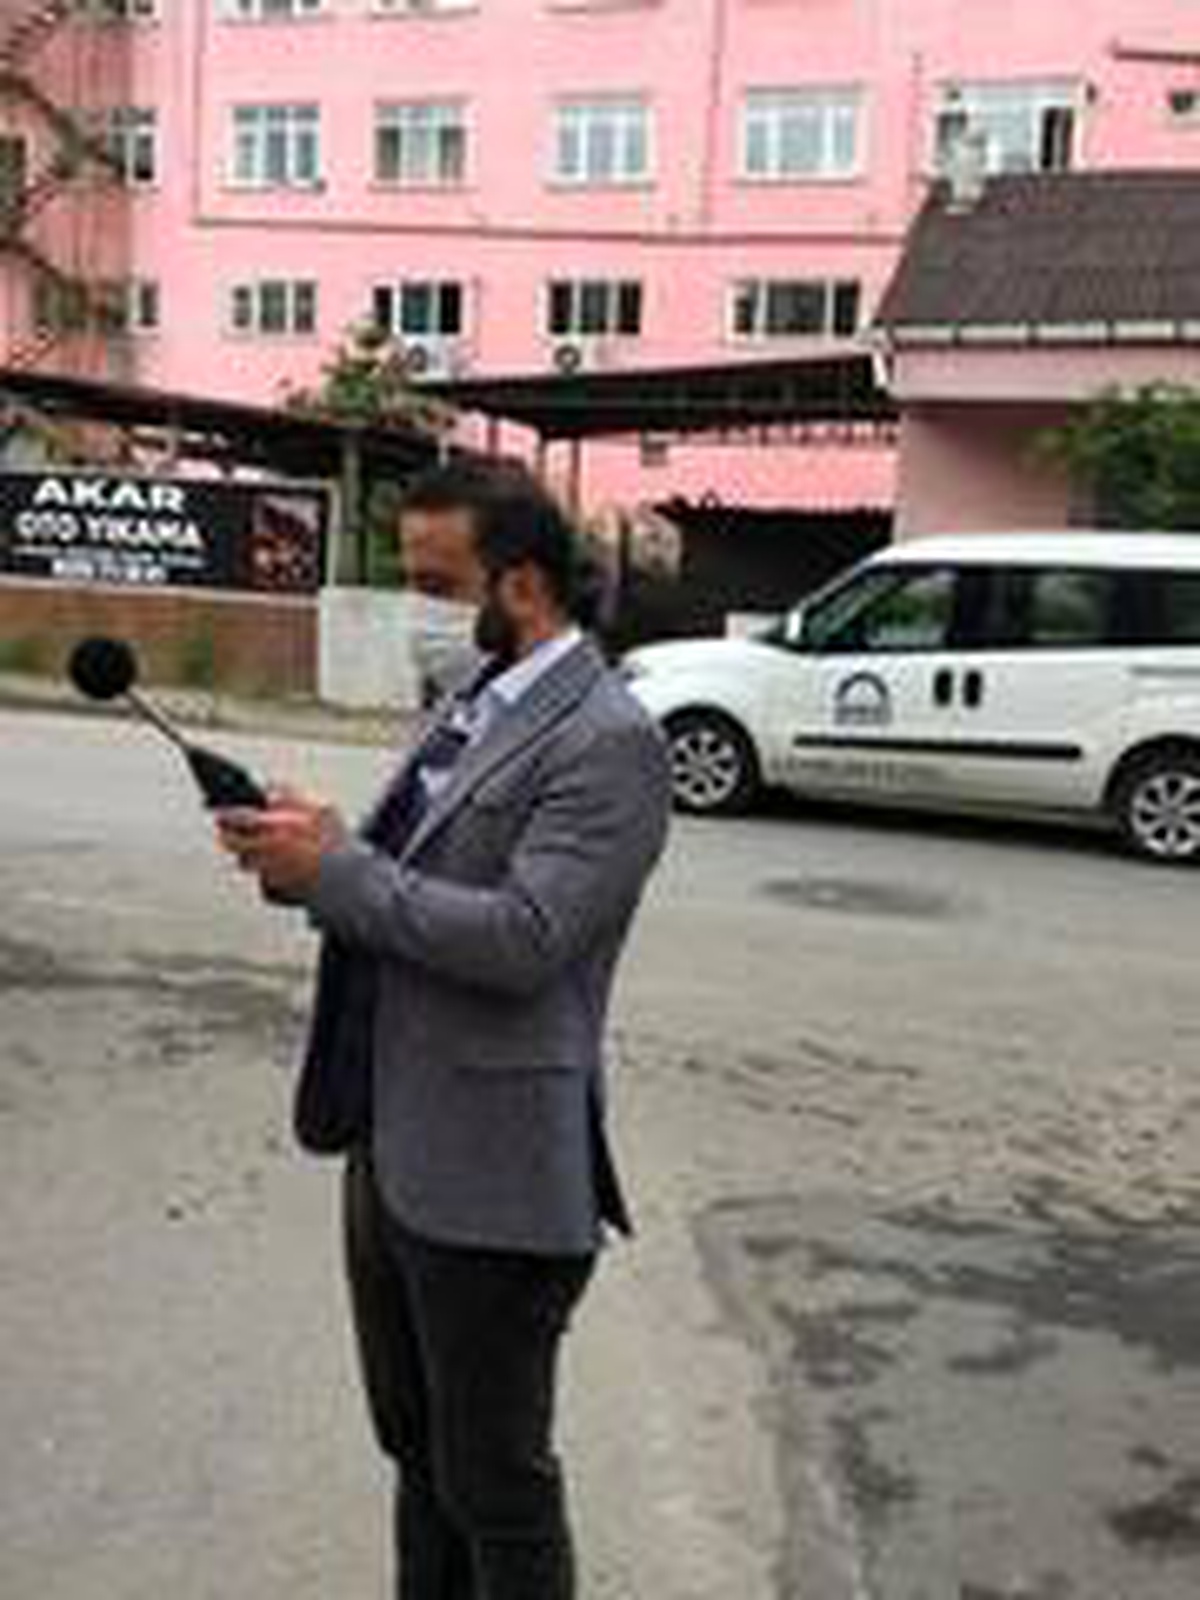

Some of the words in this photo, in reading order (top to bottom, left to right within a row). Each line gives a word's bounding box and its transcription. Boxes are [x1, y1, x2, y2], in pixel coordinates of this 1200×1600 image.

[33, 478, 186, 513] AKAR
[15, 511, 79, 542] OTO
[85, 514, 205, 549] YIKAMA
